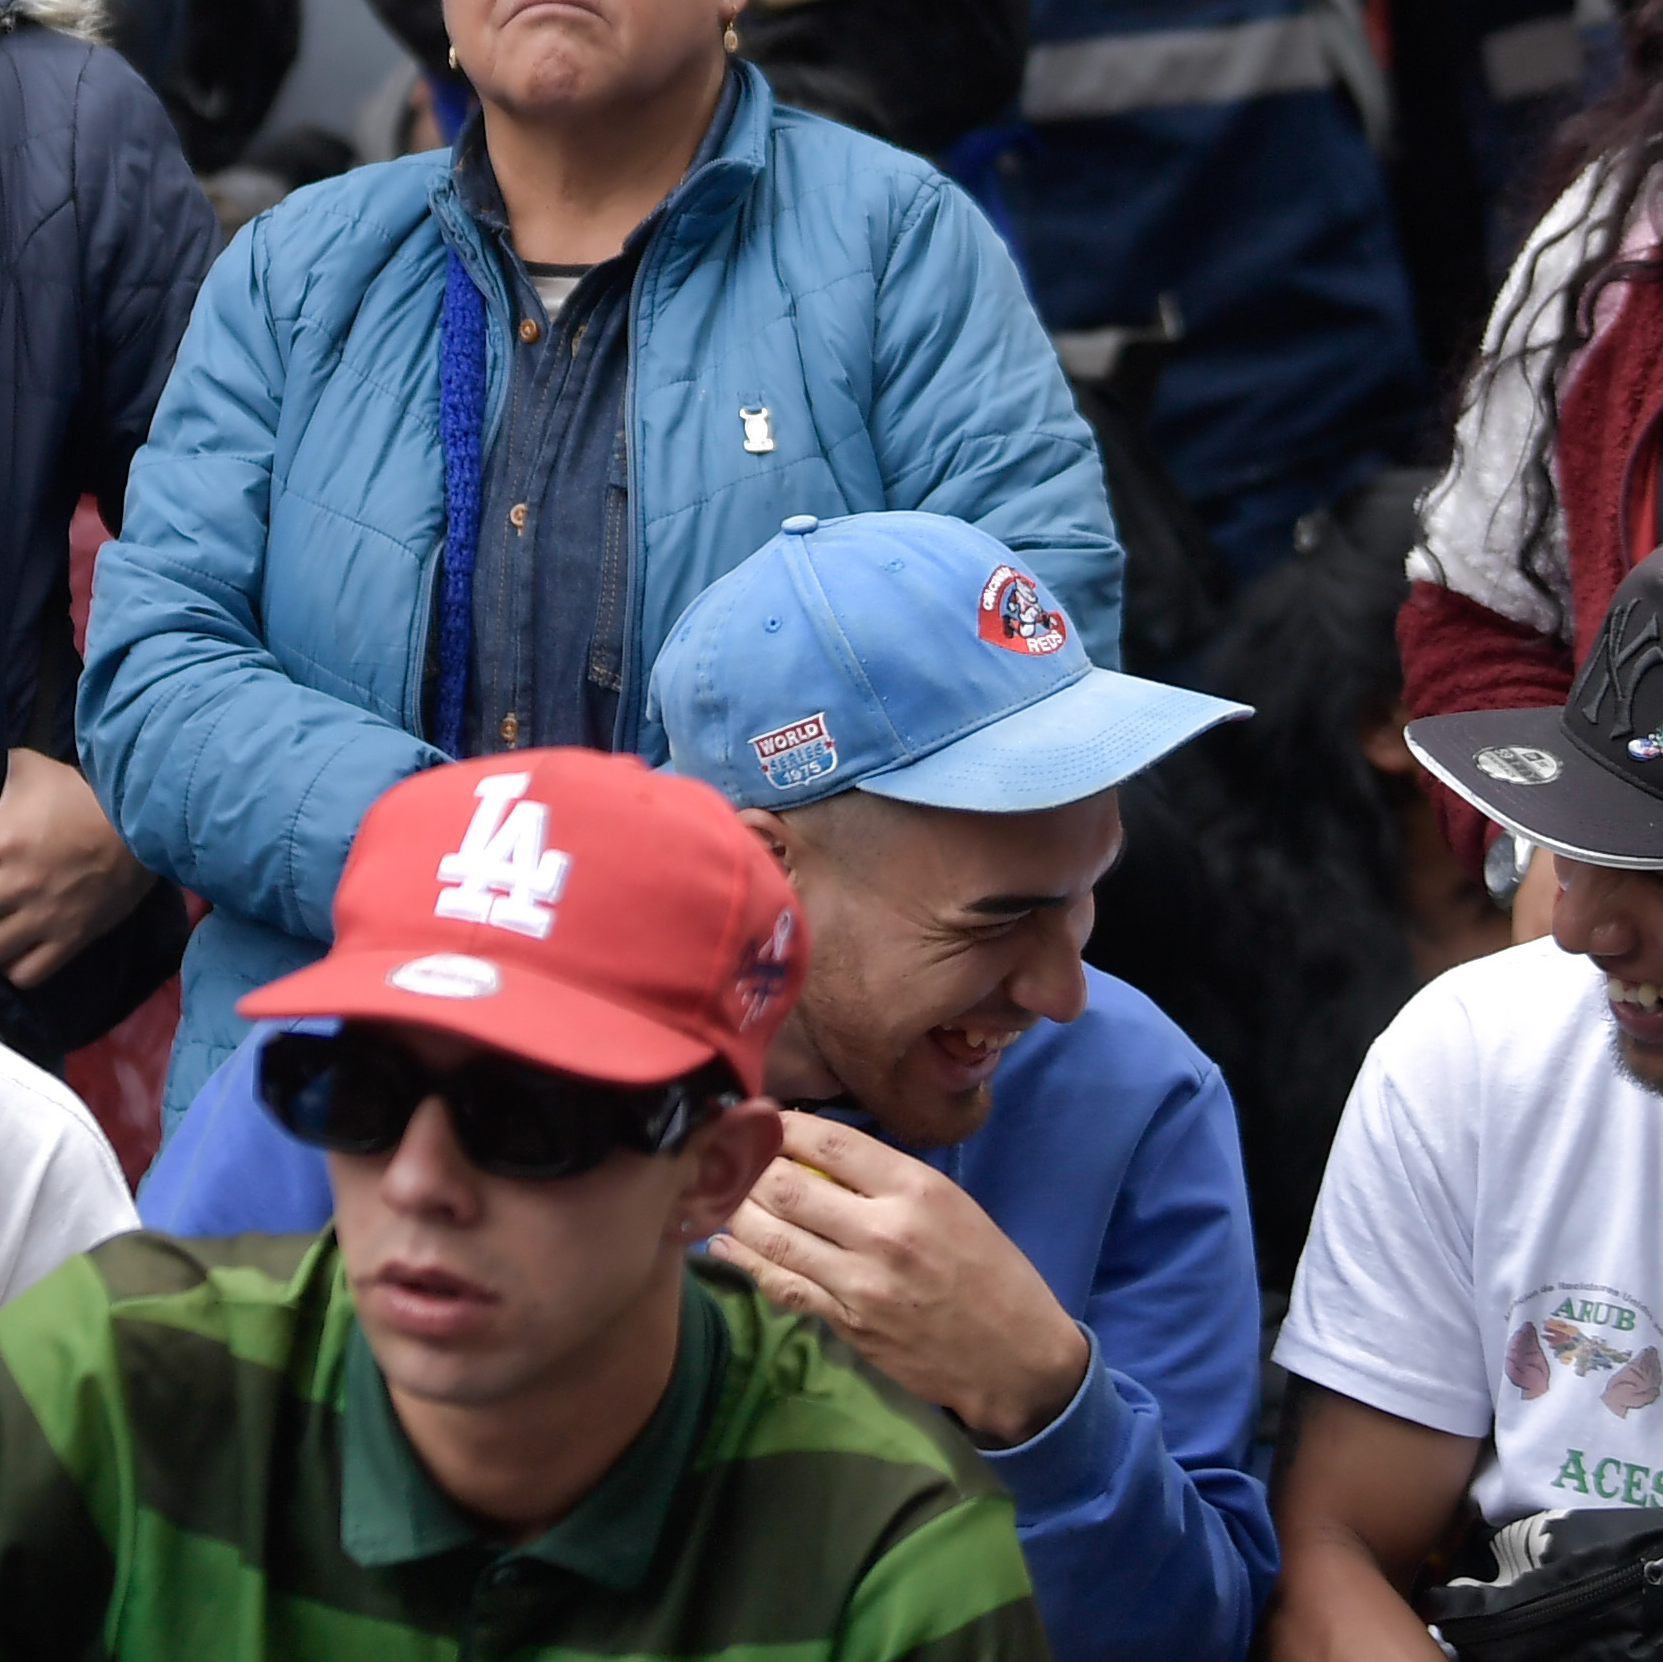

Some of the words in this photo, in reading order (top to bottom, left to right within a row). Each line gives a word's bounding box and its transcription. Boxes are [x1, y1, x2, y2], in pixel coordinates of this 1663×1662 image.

[1026, 629, 1063, 654] REDS
[758, 722, 819, 757] WORLD
[783, 759, 822, 784] 1975
[434, 770, 576, 941] LA
[1550, 1296, 1637, 1331] ARUB
